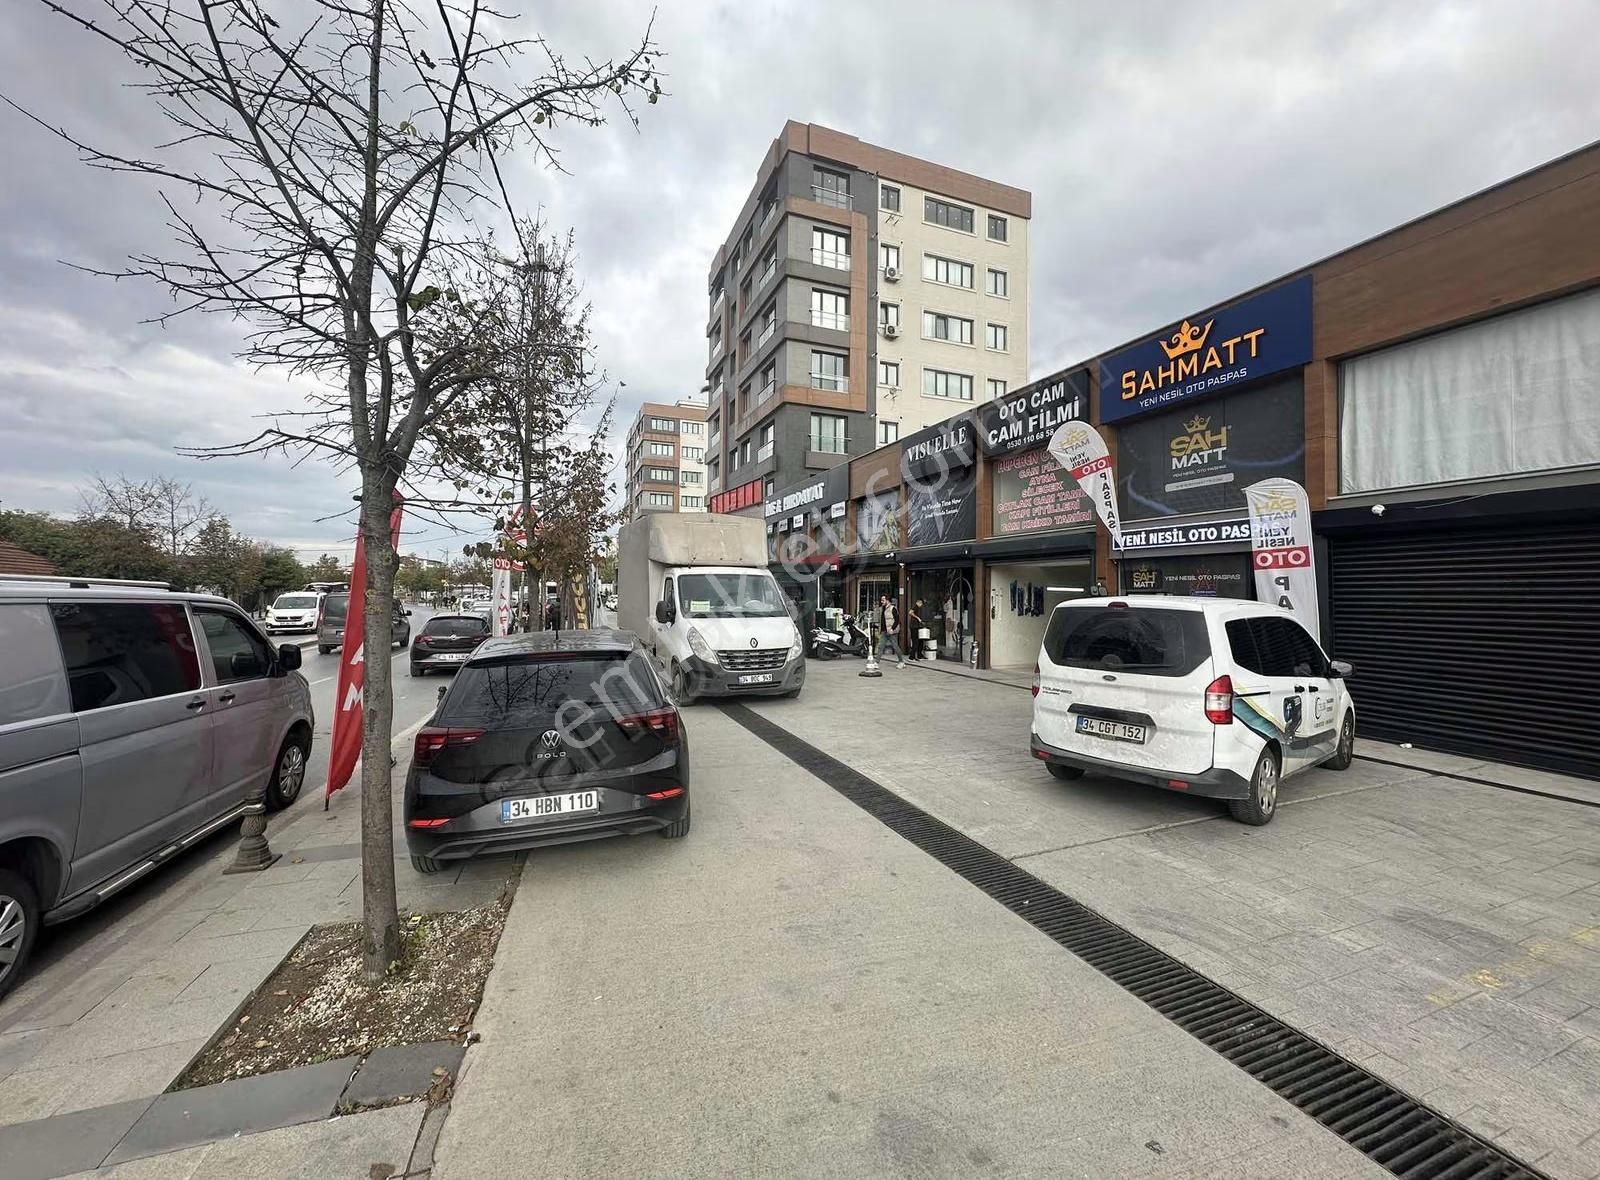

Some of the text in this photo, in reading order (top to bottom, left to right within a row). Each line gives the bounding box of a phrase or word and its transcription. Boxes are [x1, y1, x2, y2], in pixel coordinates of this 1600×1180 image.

[1121, 327, 1265, 400] SAHMATT
[1185, 380, 1205, 394] OTO
[1207, 367, 1248, 388] PASPAS
[999, 381, 1065, 421] OTO CAM
[987, 395, 1081, 446] CAM FİLMİ
[906, 426, 967, 462] VISUELLE
[1006, 438, 1022, 450] 0530
[1023, 434, 1035, 445] 110
[1170, 426, 1227, 457] SAH
[1171, 446, 1228, 470] MATT
[1149, 528, 1186, 544] NESİL
[1188, 527, 1218, 542] OTO
[1133, 571, 1155, 583] SAH
[1082, 719, 1141, 740] 34 CGT 152
[511, 792, 593, 817] 34 HBN 110
